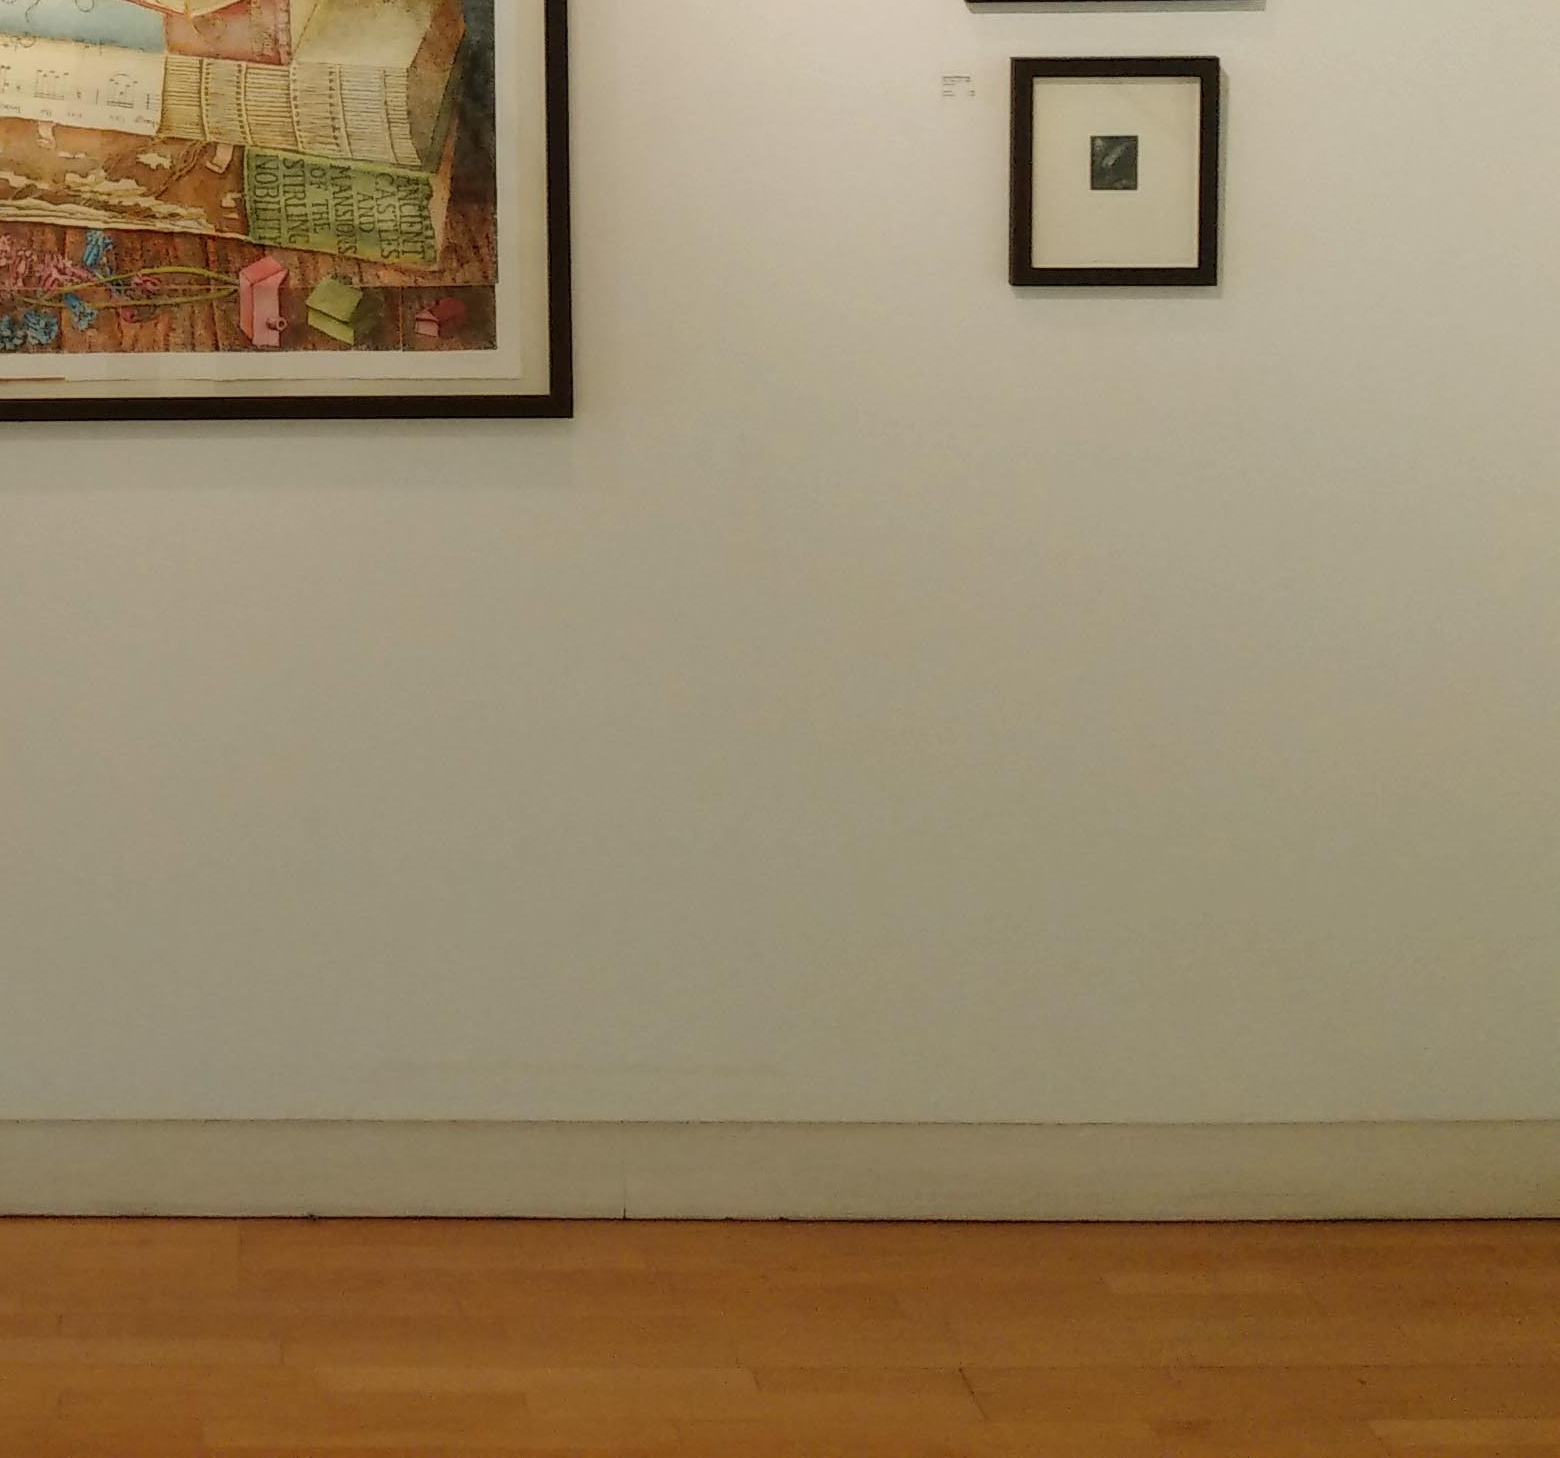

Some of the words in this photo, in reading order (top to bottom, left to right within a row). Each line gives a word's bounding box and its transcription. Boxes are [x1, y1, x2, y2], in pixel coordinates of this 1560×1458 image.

[254, 154, 282, 245] NOBILITY
[282, 158, 310, 244] STIRLING
[309, 166, 328, 191] OF
[311, 199, 331, 234] THE
[329, 164, 357, 255] MANSIONS
[356, 192, 375, 234] AND
[375, 173, 401, 259] CASTLES
